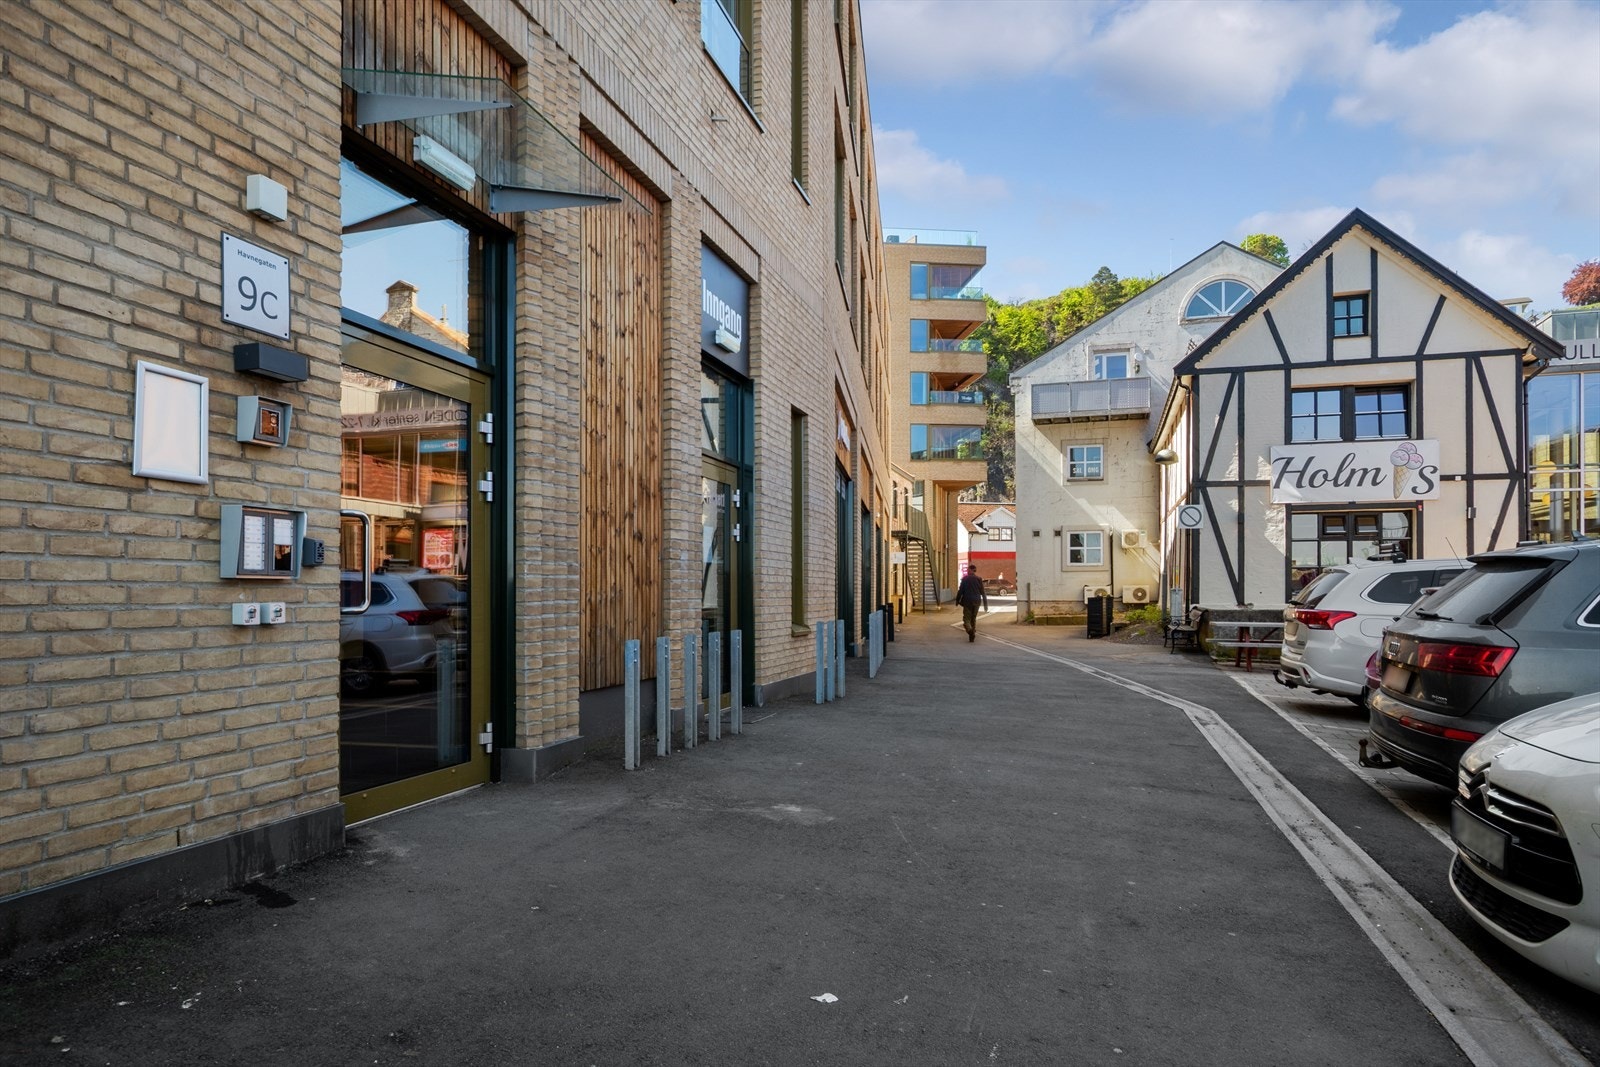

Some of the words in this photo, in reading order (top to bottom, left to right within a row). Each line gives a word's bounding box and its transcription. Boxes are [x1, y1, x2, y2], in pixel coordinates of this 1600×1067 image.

[237, 249, 277, 270] Havnegaten
[702, 279, 742, 340] Inngang
[1562, 343, 1600, 361] ULL
